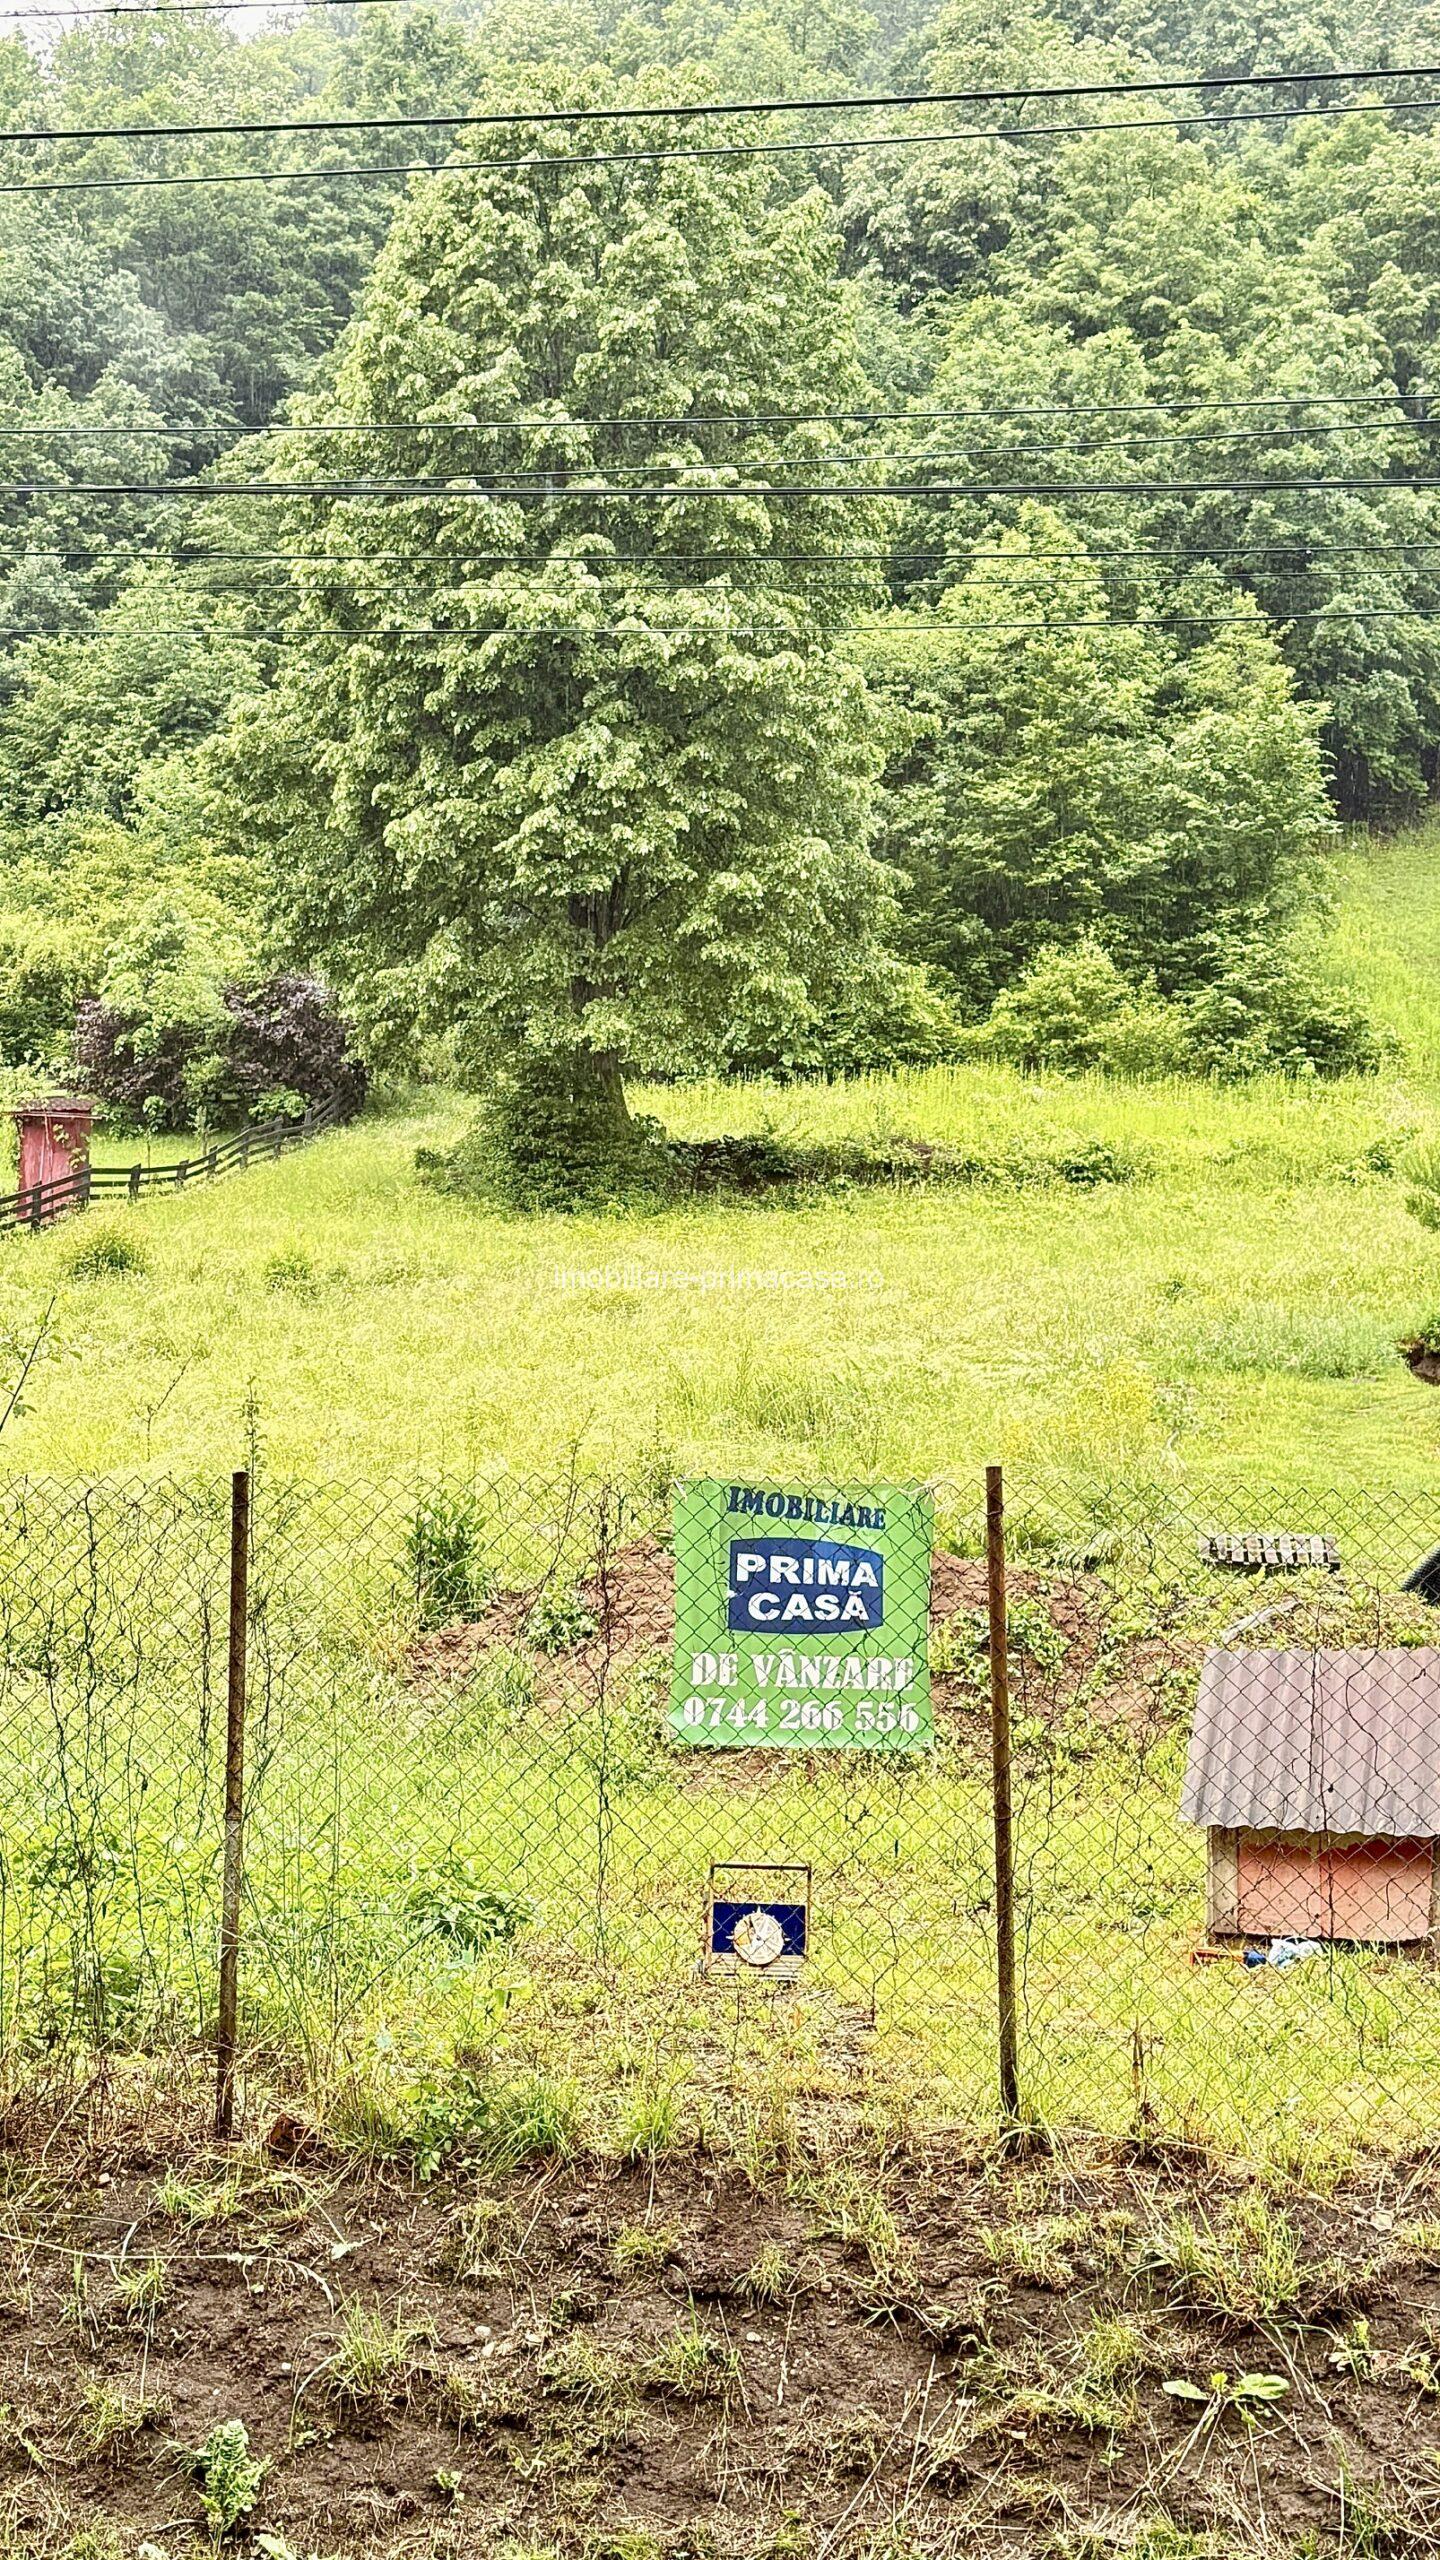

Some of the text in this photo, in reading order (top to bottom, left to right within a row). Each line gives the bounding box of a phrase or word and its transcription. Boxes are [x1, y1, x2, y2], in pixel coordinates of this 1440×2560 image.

[728, 1486, 886, 1530] IMOBILIARE
[736, 1553, 878, 1588] PRIMA
[747, 1590, 869, 1621] CASĂ
[691, 1648, 914, 1691] DE VÂNZARE
[683, 1697, 919, 1733] 0744 266 556
